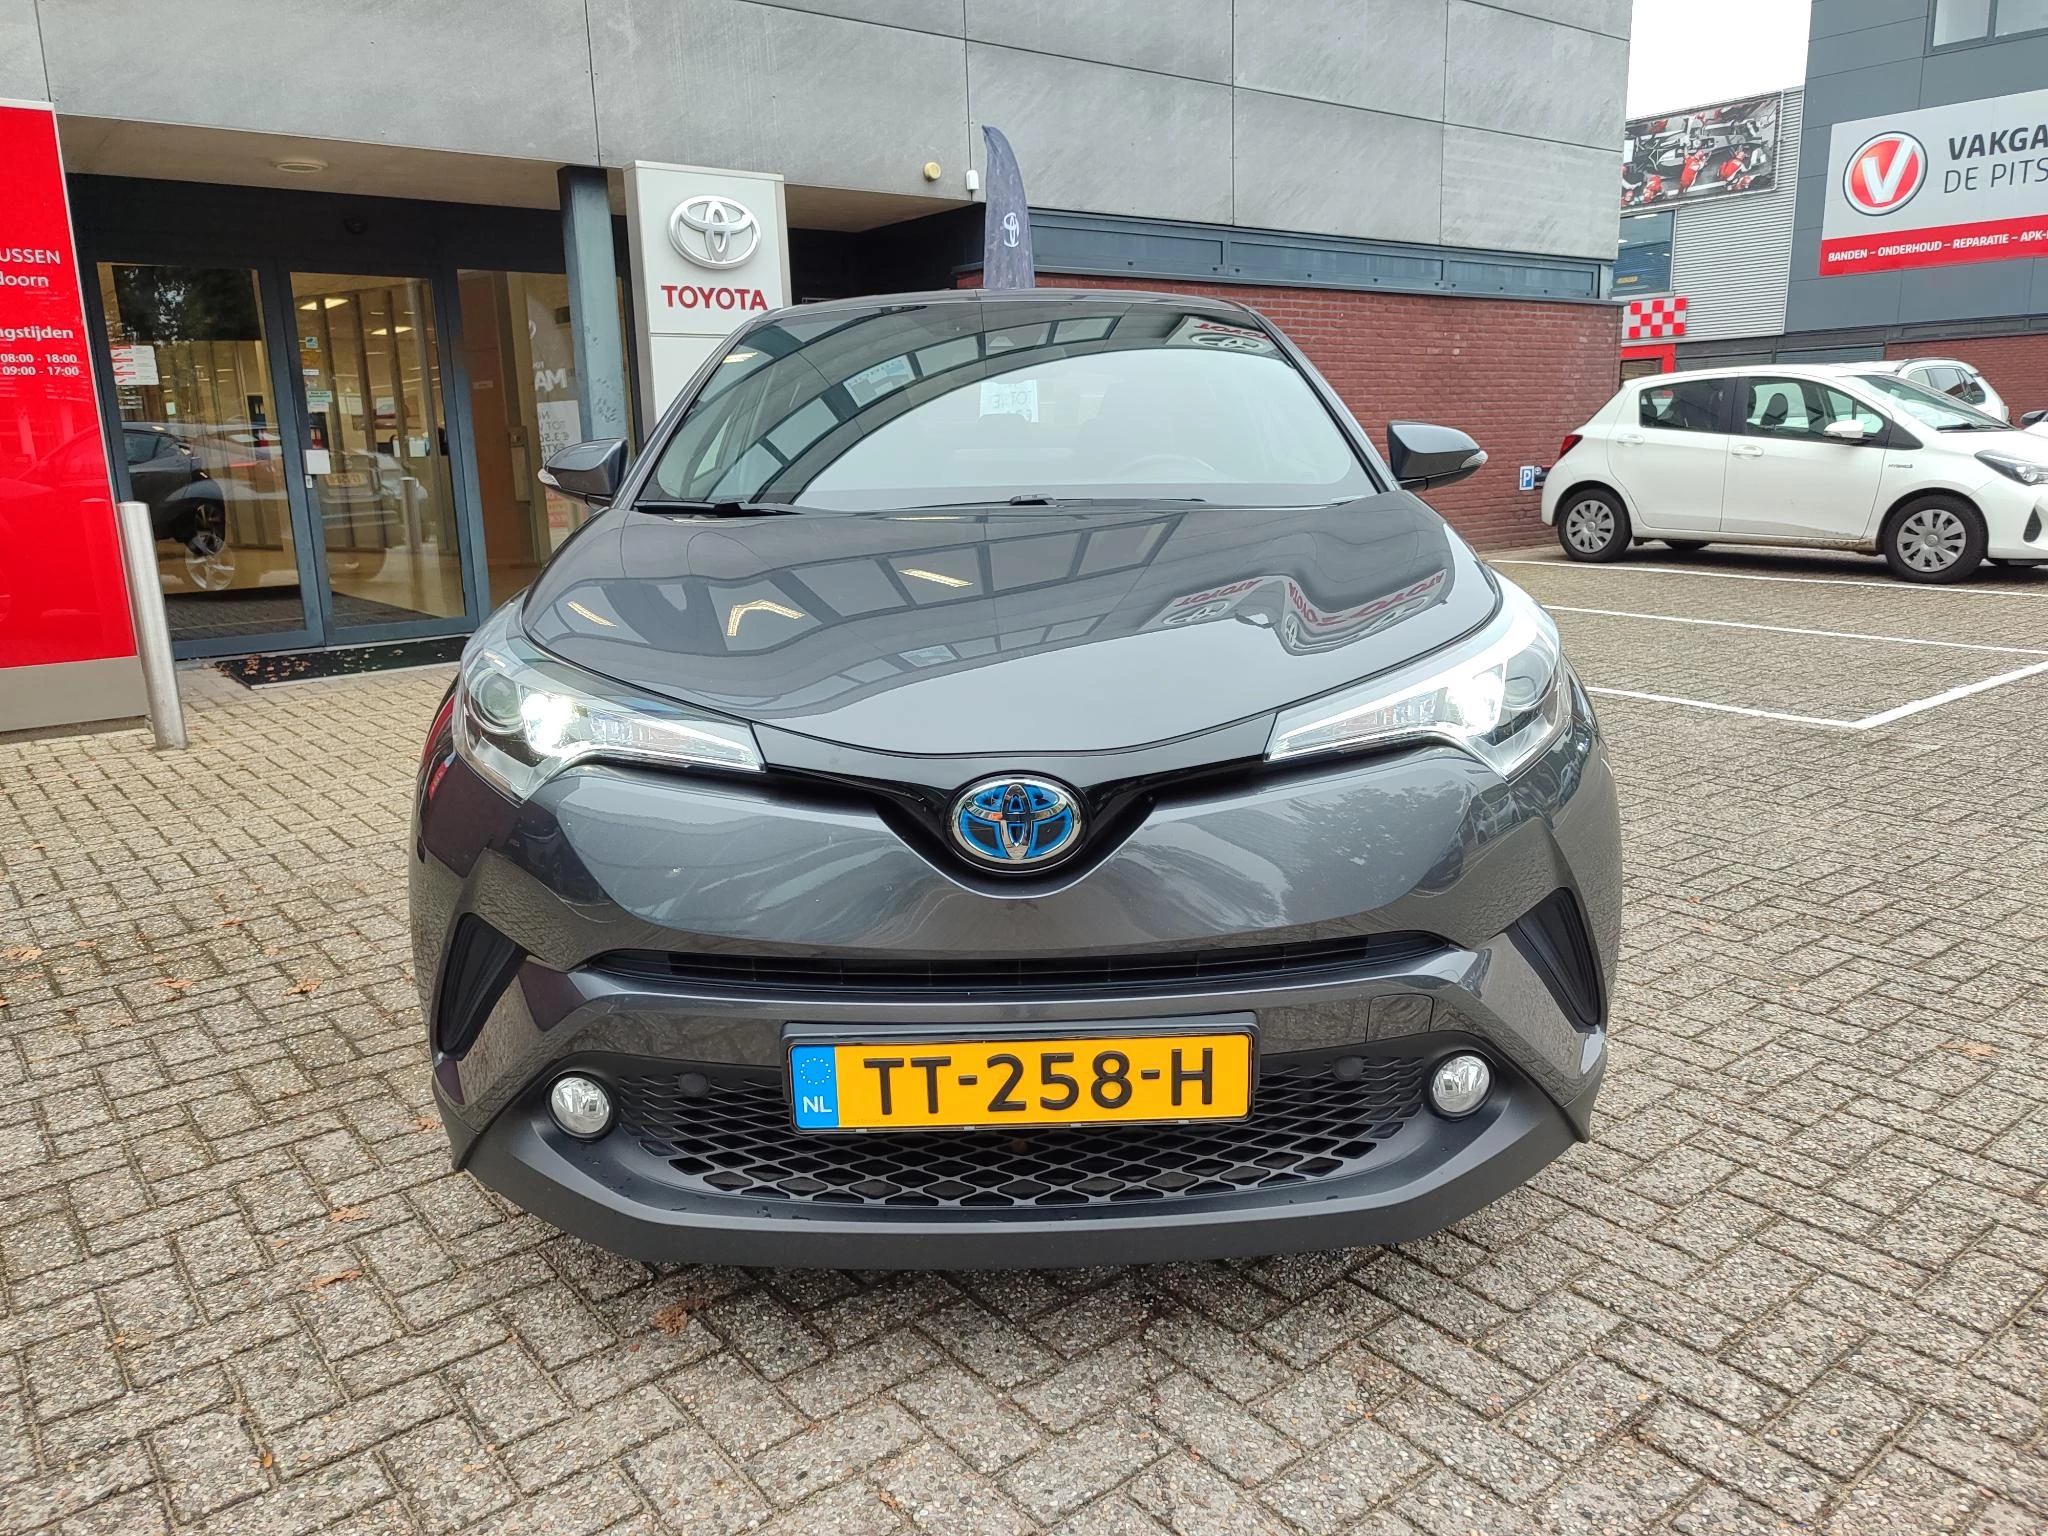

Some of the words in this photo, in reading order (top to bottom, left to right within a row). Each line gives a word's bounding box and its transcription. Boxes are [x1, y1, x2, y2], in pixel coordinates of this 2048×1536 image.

[1948, 124, 2048, 160] VAKGA
[1944, 166, 1979, 194] DE
[1990, 157, 2048, 188] PITS
[0, 248, 61, 264] USSEN
[1828, 249, 1868, 262] BANDEN
[1877, 241, 1942, 257] ONDERHOUD
[1952, 233, 2009, 249] REPARATIE
[2019, 229, 2048, 243] APK-
[660, 285, 768, 311] TOYOTA
[0, 354, 34, 363] 08:00
[45, 354, 77, 363] 18:00
[2, 366, 36, 376] 09:00
[47, 366, 80, 376] 17:00
[802, 1095, 833, 1113] NL
[863, 1047, 1214, 1116] TT-258-H
